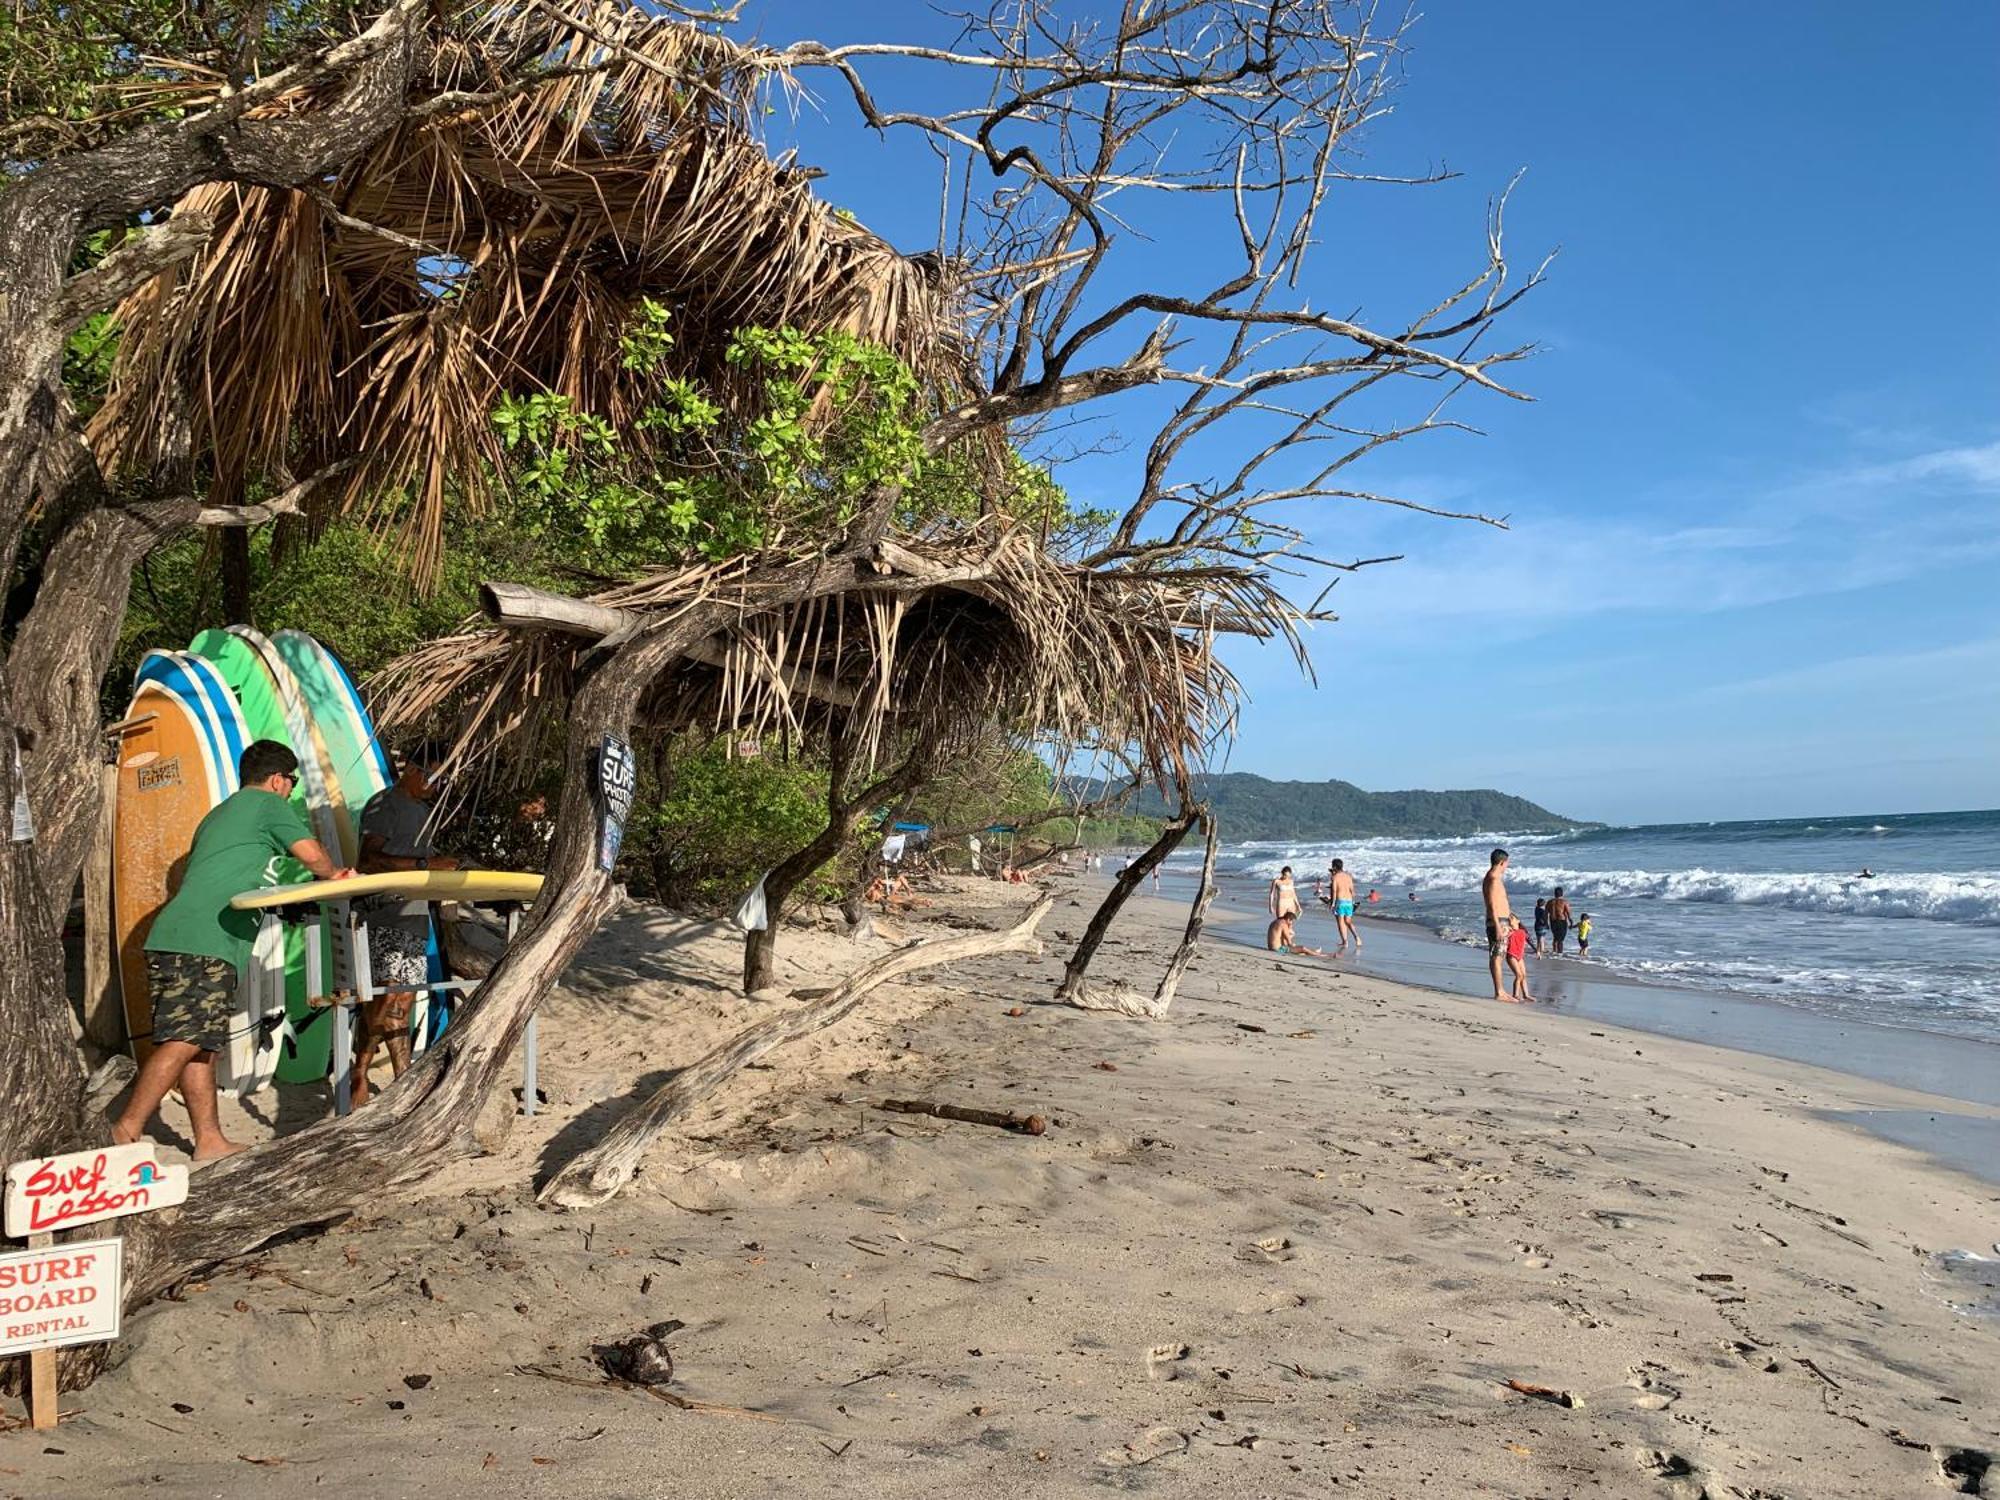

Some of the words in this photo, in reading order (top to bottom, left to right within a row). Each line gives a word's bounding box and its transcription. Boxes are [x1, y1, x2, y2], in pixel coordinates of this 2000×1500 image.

[602, 758, 634, 792] SURF
[25, 1154, 107, 1197] Surf
[30, 1189, 149, 1230] Lesson
[0, 1254, 96, 1289] SURF
[6, 1315, 90, 1339] RENTAL
